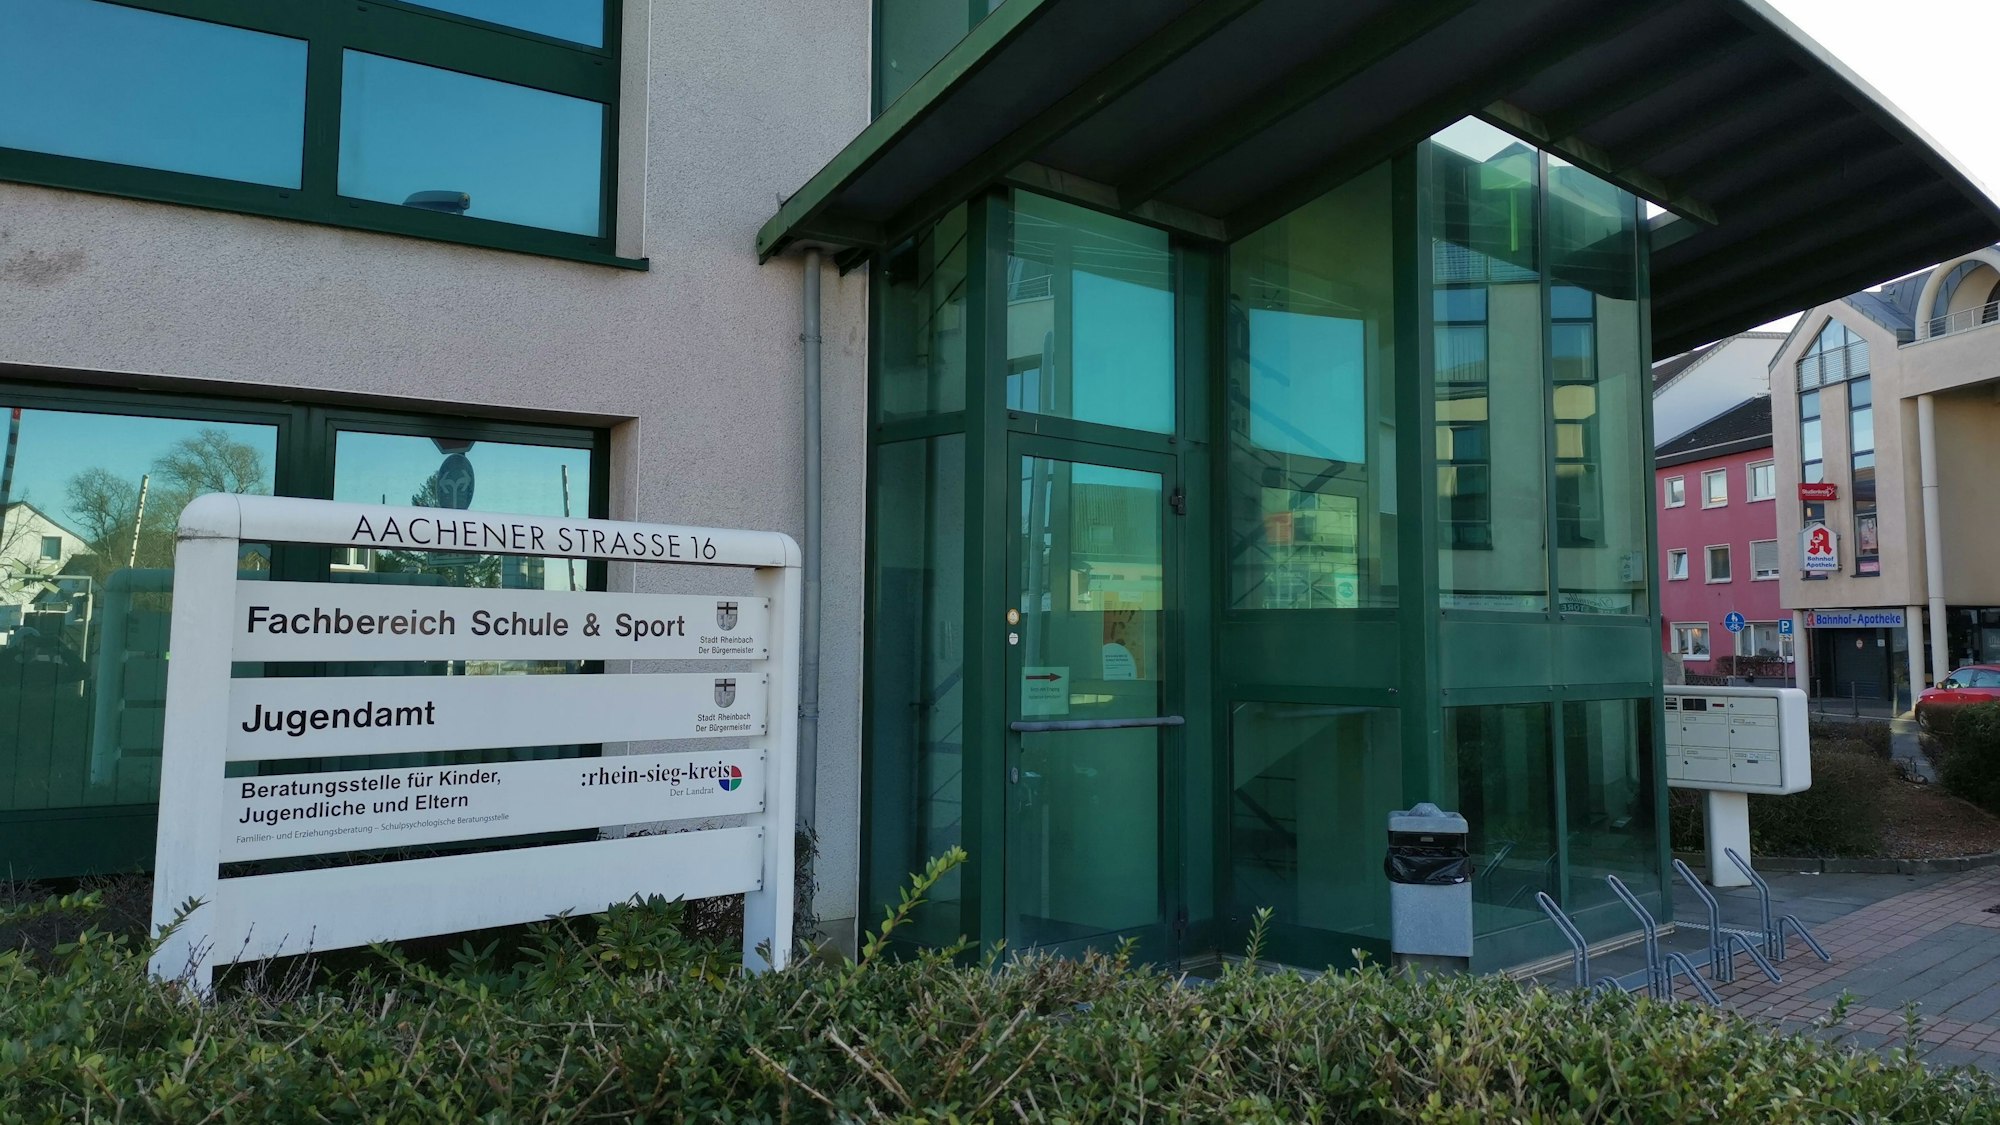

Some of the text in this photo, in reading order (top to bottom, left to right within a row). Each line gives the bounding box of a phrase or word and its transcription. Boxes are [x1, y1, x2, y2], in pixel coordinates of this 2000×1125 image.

[351, 514, 717, 560] AACHENER STRASSE 16
[247, 605, 686, 642] Fachbereich Schule & Sport
[1781, 620, 1790, 633] P
[699, 635, 754, 644] Stadt Rheinbach
[698, 646, 755, 656] Der Bürgermeister
[241, 700, 436, 737] Jugendamt
[695, 722, 752, 733] Der Bürgermeister
[697, 712, 751, 722] Stadt Rheinbach
[241, 769, 502, 799] Beratungsstelle für Kinder,
[669, 787, 715, 797] Der Landrat
[239, 794, 469, 826] Jugendliche und Eltern
[236, 833, 275, 844] Familien-
[276, 831, 293, 840] und
[294, 825, 373, 839] Erziehungsberatung
[381, 818, 456, 832] Schulpsychologische
[457, 813, 510, 825] Beratungsstelle
